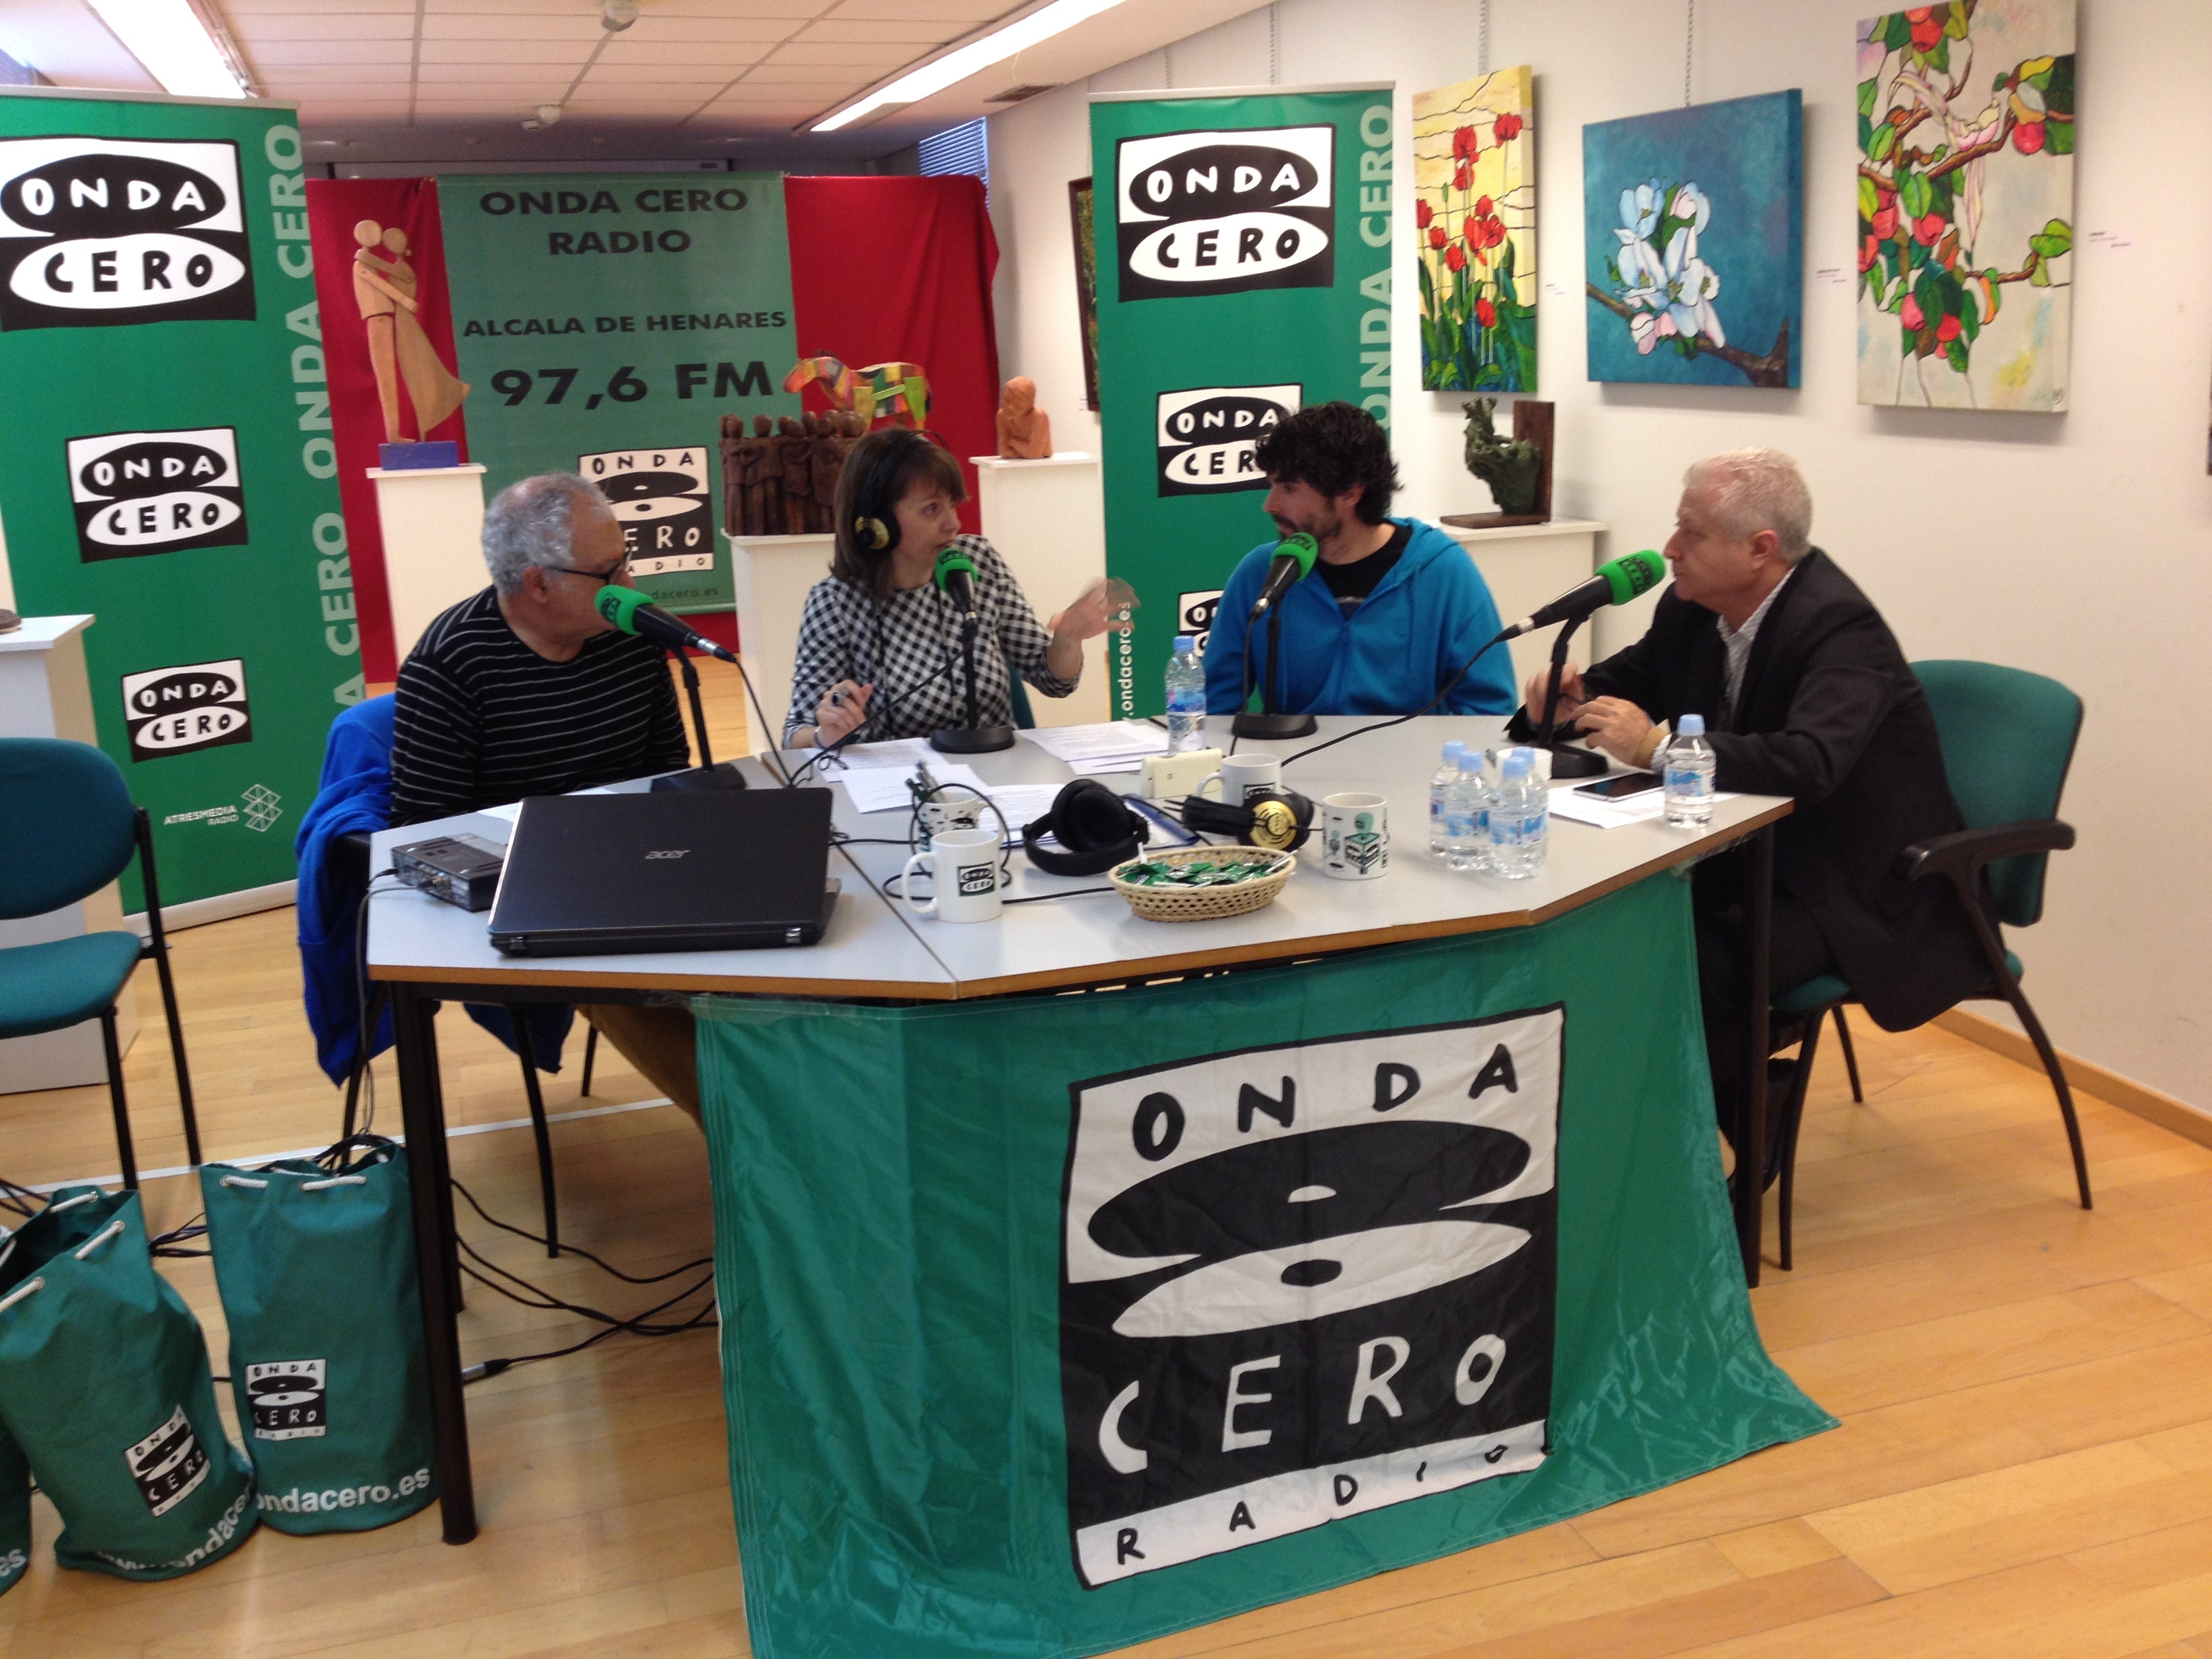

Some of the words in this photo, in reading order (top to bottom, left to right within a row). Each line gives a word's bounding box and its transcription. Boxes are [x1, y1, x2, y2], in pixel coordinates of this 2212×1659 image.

[1146, 162, 1300, 203] ONDA
[1359, 104, 1393, 248] CERO
[20, 178, 206, 216] ONDA
[264, 124, 314, 279] CERO
[479, 190, 621, 216] ONDA
[634, 188, 748, 212] CERO
[548, 229, 691, 255] RADIO
[1157, 227, 1300, 269] CERO
[43, 250, 213, 293] CERO
[462, 316, 585, 337] ALCALA
[596, 315, 635, 333] DE
[647, 311, 787, 331] HENARES
[1359, 268, 1391, 430] ONDA
[285, 300, 338, 480] ONDA
[490, 365, 649, 411] 97,6
[674, 361, 773, 399] FM
[1176, 408, 1279, 434] ONDA
[92, 455, 216, 487] ONDA
[592, 451, 694, 474] ONDA
[1184, 450, 1255, 476] CER
[108, 502, 219, 535] CERO
[623, 525, 701, 552] ERO
[628, 557, 705, 573] ADIO
[312, 512, 361, 657] CERO
[140, 680, 228, 707] ONDA
[151, 714, 231, 741] CERO
[207, 815, 240, 826] RADIO
[644, 849, 691, 860] acer
[1131, 1044, 1519, 1162] ONDA
[253, 1362, 317, 1377] ONDA
[253, 1409, 317, 1427] CERO
[1098, 1332, 1508, 1475] CERO
[148, 1449, 203, 1502] CERO
[1116, 1445, 1509, 1565] RADIO
